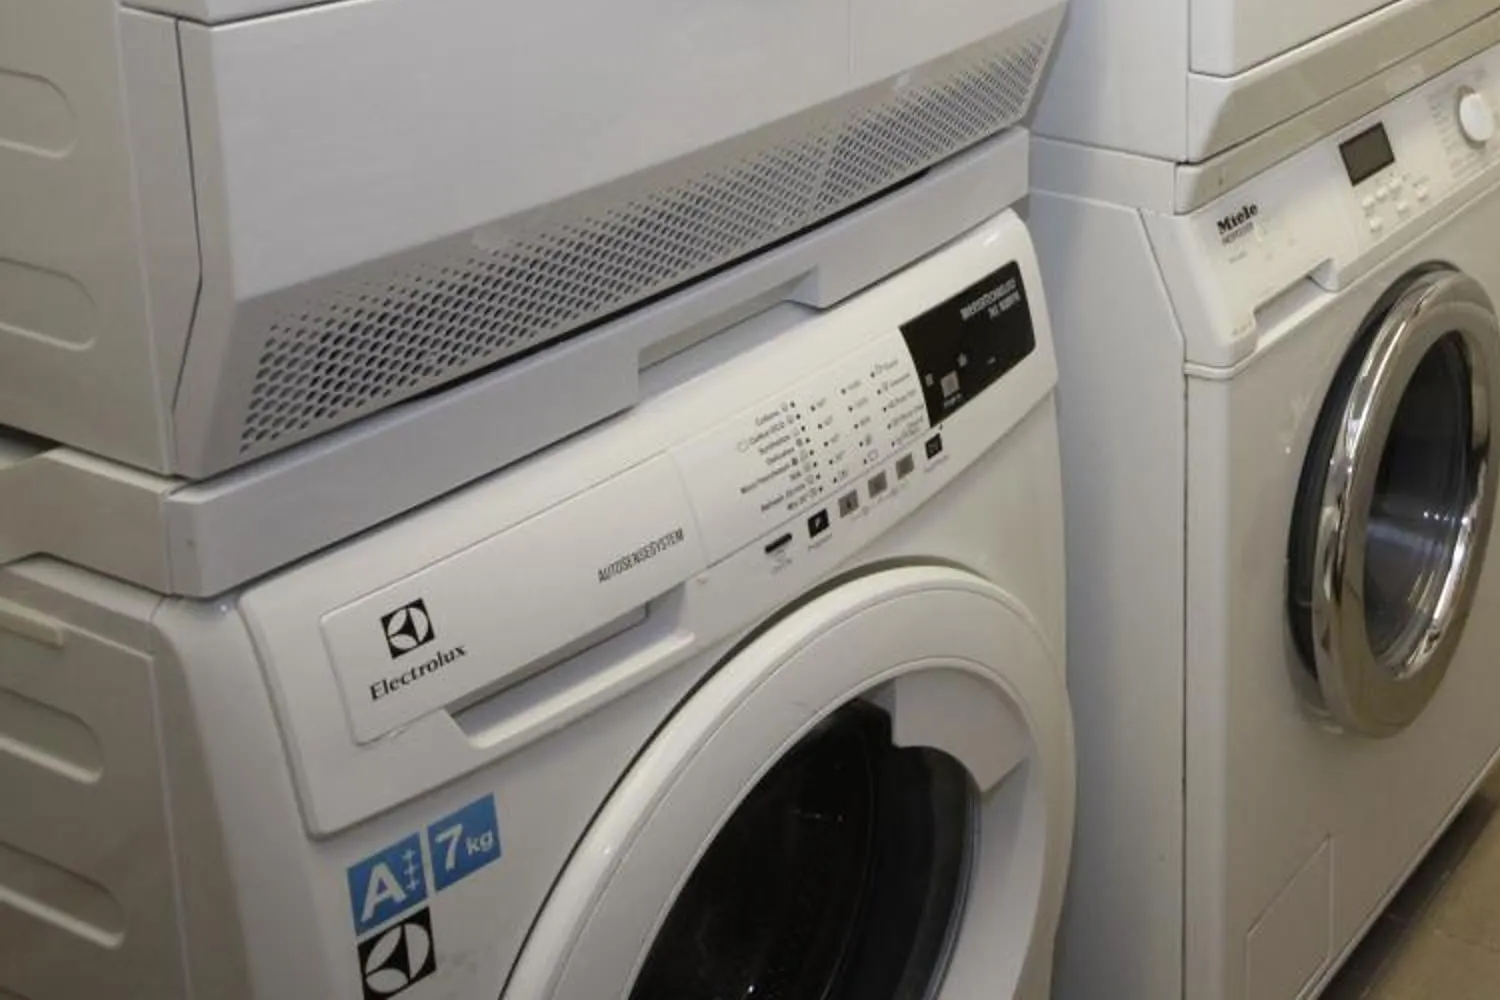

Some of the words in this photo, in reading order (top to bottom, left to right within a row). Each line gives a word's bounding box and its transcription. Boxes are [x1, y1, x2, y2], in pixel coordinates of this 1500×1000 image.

[1217, 204, 1258, 235] Miele
[369, 645, 467, 701] Electrolux
[434, 823, 464, 872] 7
[466, 831, 494, 857] kg
